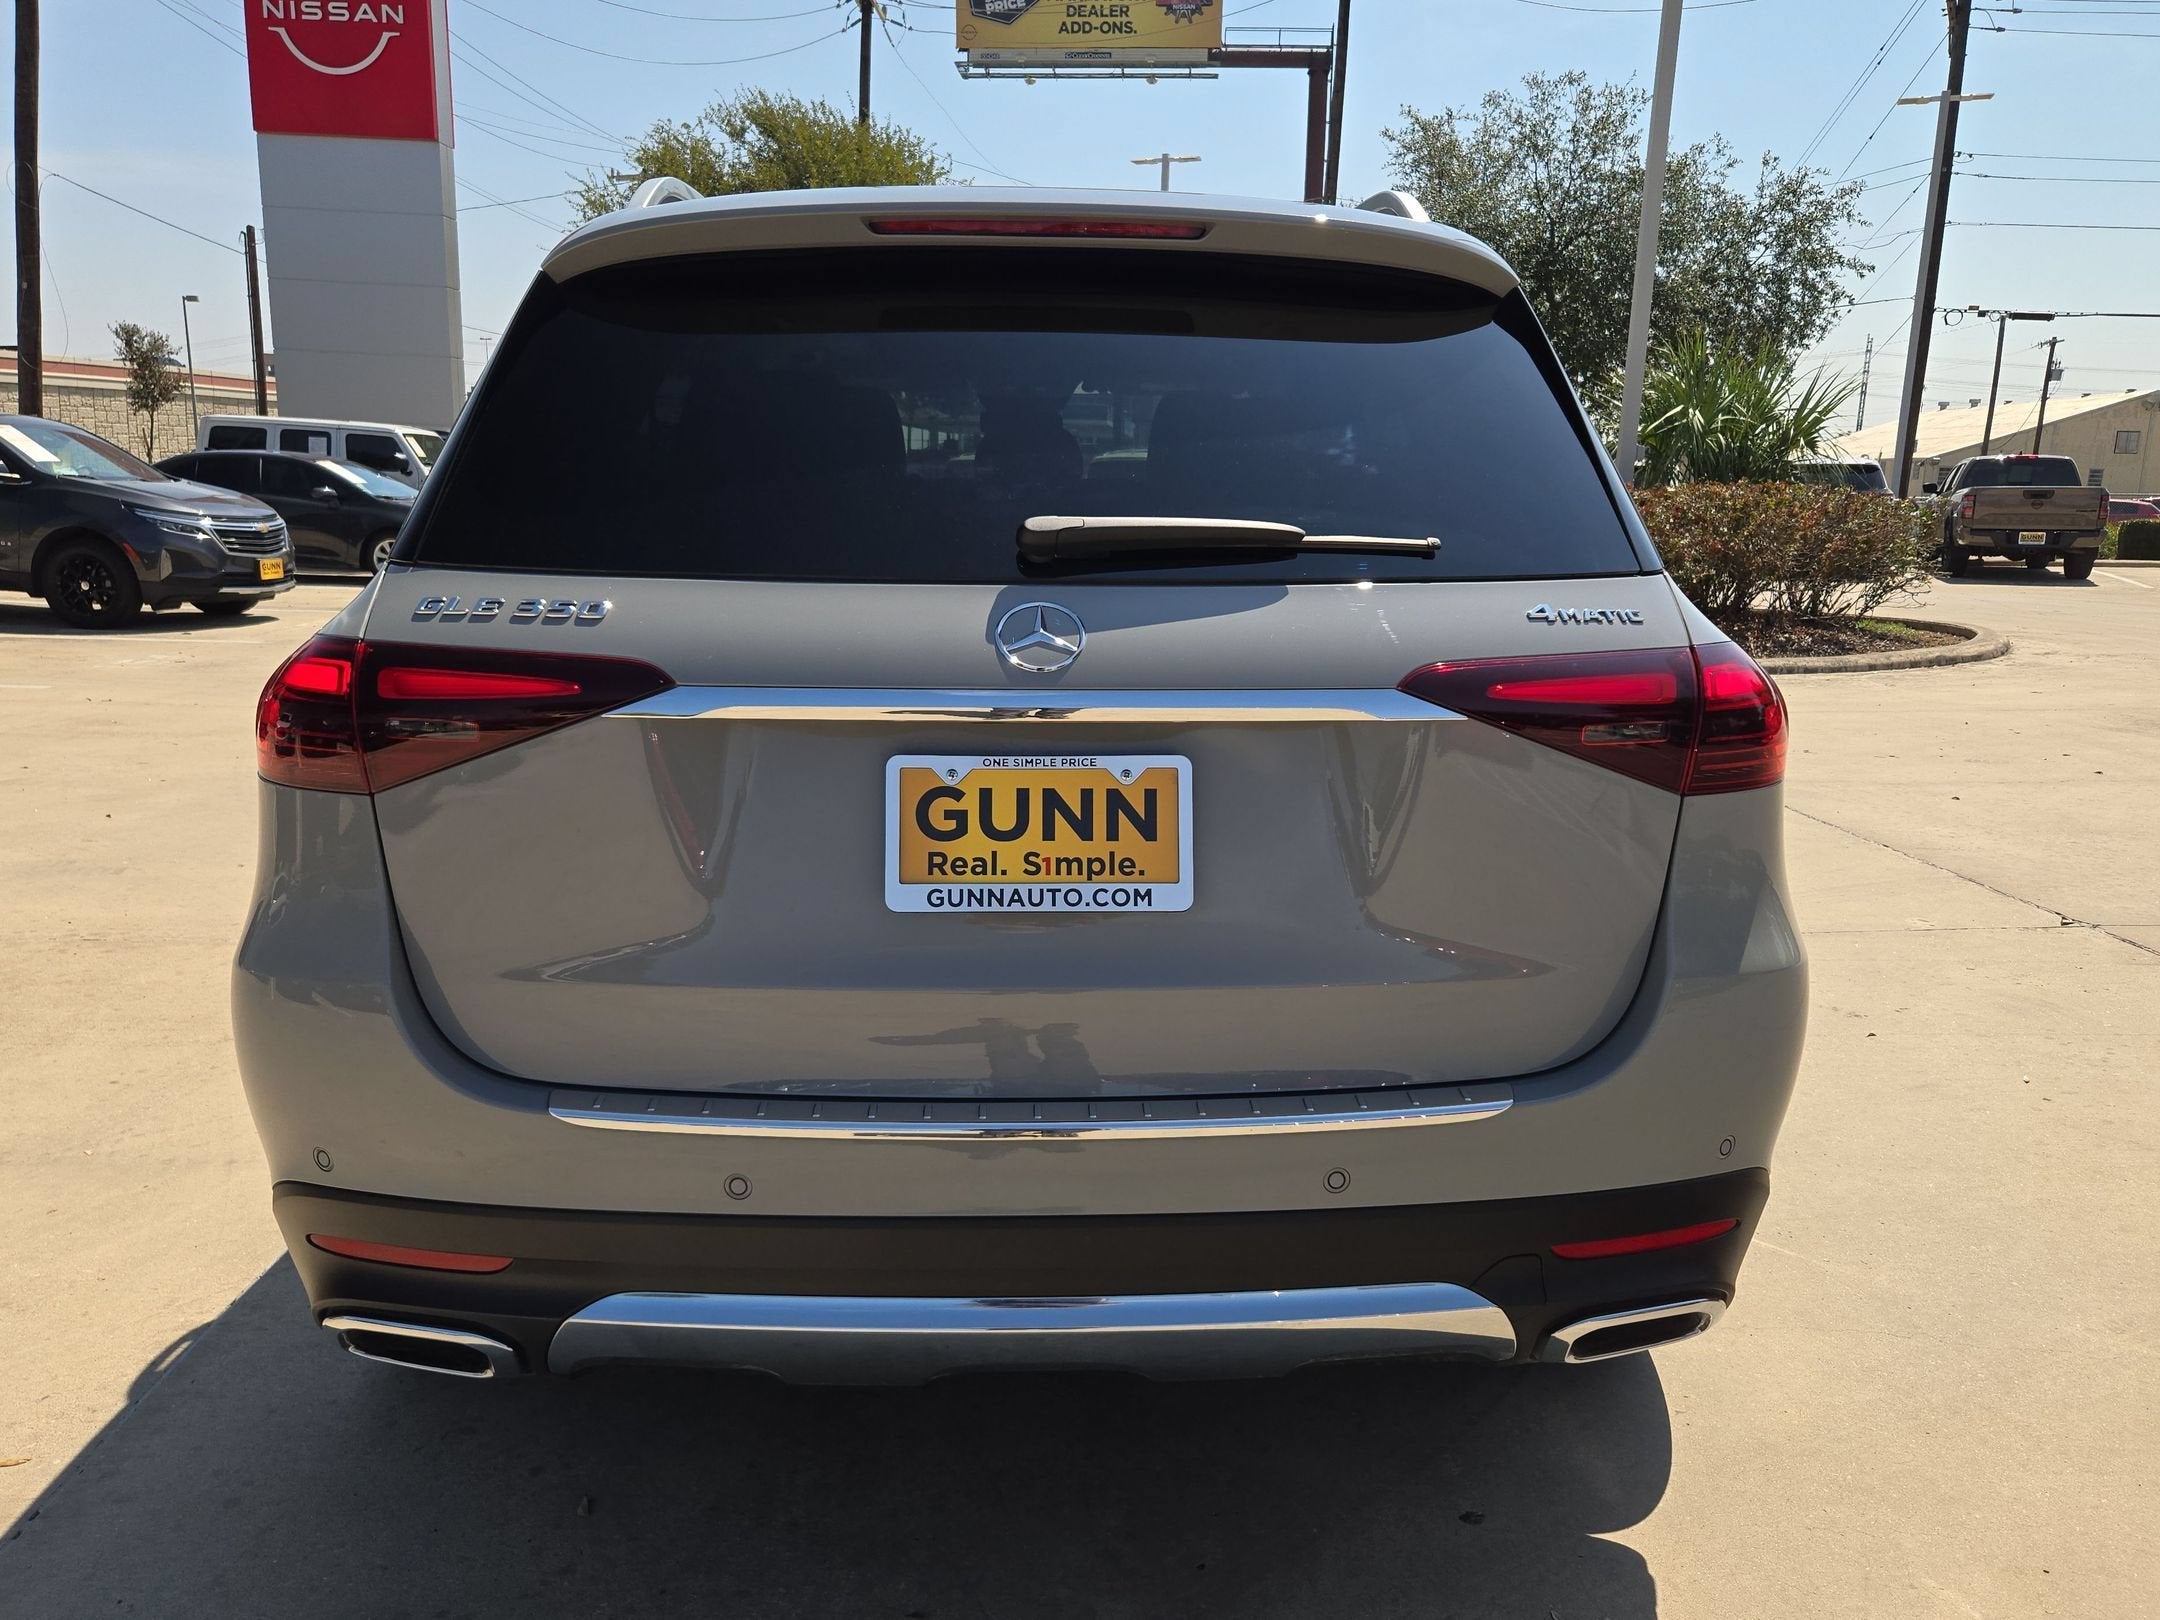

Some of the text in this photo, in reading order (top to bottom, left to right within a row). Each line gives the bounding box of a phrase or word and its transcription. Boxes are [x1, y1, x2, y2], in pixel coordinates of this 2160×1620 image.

[263, 0, 405, 24] NISSAN
[985, 0, 1027, 14] PRICE
[1066, 5, 1130, 18] DEALER
[1058, 21, 1138, 35] ADD-ONS.
[513, 599, 613, 619] 350
[1526, 602, 1645, 625] 4MATIC
[982, 758, 1097, 767] ONE SIMPLE PRICE
[915, 785, 1158, 842] GUNN
[927, 851, 1008, 876] Real.
[926, 888, 1153, 907] GUNNAUTO.COM
